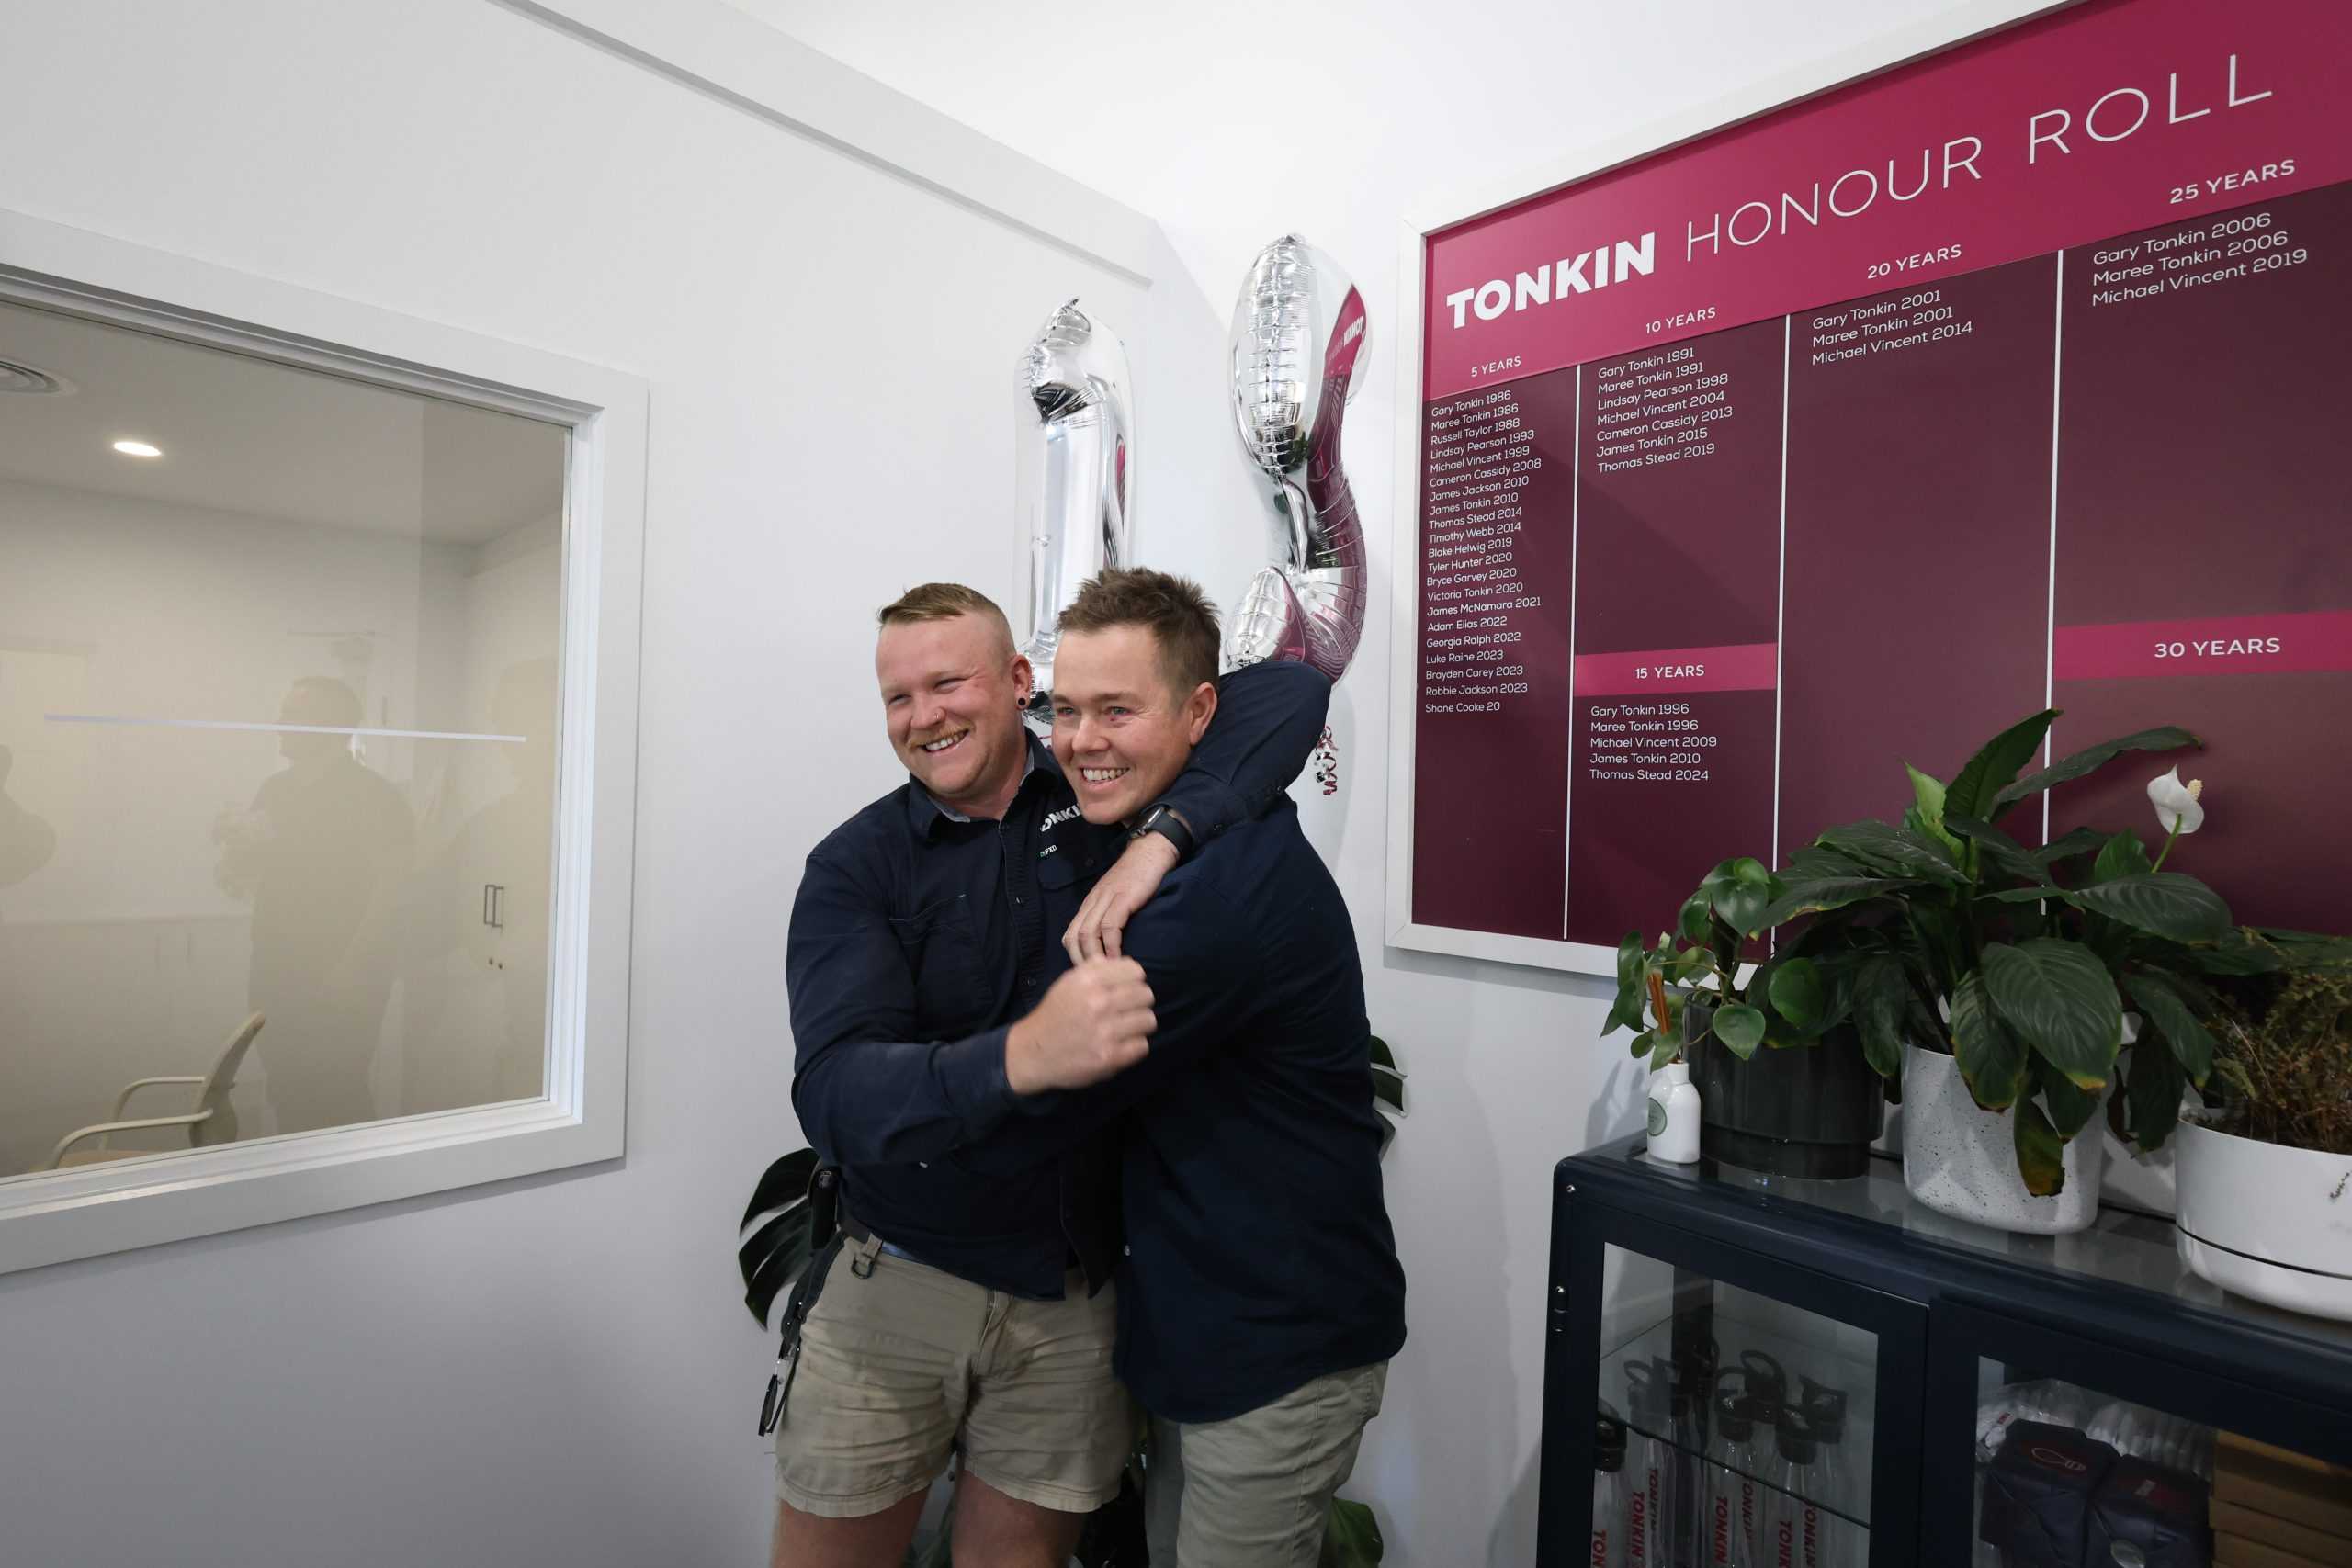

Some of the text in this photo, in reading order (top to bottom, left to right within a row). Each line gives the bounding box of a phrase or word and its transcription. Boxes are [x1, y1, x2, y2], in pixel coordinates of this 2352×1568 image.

[1447, 54, 2273, 330] TONKIN HONOUR ROLL
[2170, 159, 2295, 204] 25 YEARS
[2093, 212, 2271, 265] Gary Tonkin 2006
[1868, 244, 1962, 279] 20 YEARS
[2093, 231, 2288, 287] Maree Tonkin 2006
[2092, 248, 2307, 307] Michael Vincent 2019
[1645, 307, 1716, 334] 10 YEARS
[1813, 289, 1941, 330] Gary Tonkin 2001
[1813, 306, 1952, 348] Maree Tonkin 2001
[1812, 321, 1973, 366] Michael Vincent 2014
[1471, 355, 1521, 378] 5 YEARS
[1598, 347, 1694, 378] Gary Tonkin 1991
[1598, 361, 1703, 395] Maree Tonkin 1991
[1431, 389, 1511, 417] Gary Tonkin 1986
[1598, 373, 1728, 411] Lindsay Pearson 1998
[1431, 402, 1519, 432] Maree Tonkin 1986
[1597, 390, 1724, 426] Michael Vincent 2004
[1430, 417, 1521, 446] Russell Taylor 1988
[1597, 406, 1733, 442] Cameron Cassidy 2013
[1430, 429, 1535, 460] Lindsay Pearson 1993
[1596, 426, 1708, 457] James Tonkin 2015
[1430, 445, 1530, 474] Michael Vincent 1999
[1598, 443, 1715, 473] Thomas Stead 2019
[1430, 457, 1542, 488] Cameron Cassidy 2008
[1429, 475, 1530, 502] James Jackson 2010
[1429, 491, 1519, 516] James Tonkin 2010
[1429, 506, 1522, 530] Thomas Stead 2014
[1428, 521, 1521, 544] Timothy Webb 2014
[1428, 536, 1512, 558] Blake Helwig 2019
[1428, 551, 1512, 575] Tyler Hunter 2020
[1427, 567, 1517, 589] Bryce Garvey 2020
[1427, 581, 1523, 602] Victoria Tonkin 2020
[1427, 596, 1541, 616] James McNamara 2021
[1427, 615, 1508, 632] Adam Elias 2022
[1426, 631, 1521, 650] Georgia Ralph 2022
[2155, 637, 2280, 658] 30 YEARS
[1426, 649, 1504, 664] Luke Raine 2023
[1426, 665, 1523, 682] Brayden Carey 2023
[1635, 664, 1704, 679] 15 YEARS
[1425, 682, 1528, 696] Robbie Jackson 2023
[1425, 701, 1500, 713] Shane Cooke 20
[1590, 703, 1690, 719] Gary Tonkin 1996
[1590, 719, 1699, 732] Maree Tonkin 1996
[1590, 736, 1717, 748] Michael Vincent 2009
[1589, 752, 1701, 764] James Tonkin 2010
[1589, 769, 1709, 781] Thomas Stead 2024
[1040, 804, 1081, 831] ONKI
[1742, 1480, 1754, 1540] ONKIN
[1632, 1491, 1645, 1557] TONKIN
[1714, 1497, 1728, 1563] TONKIN
